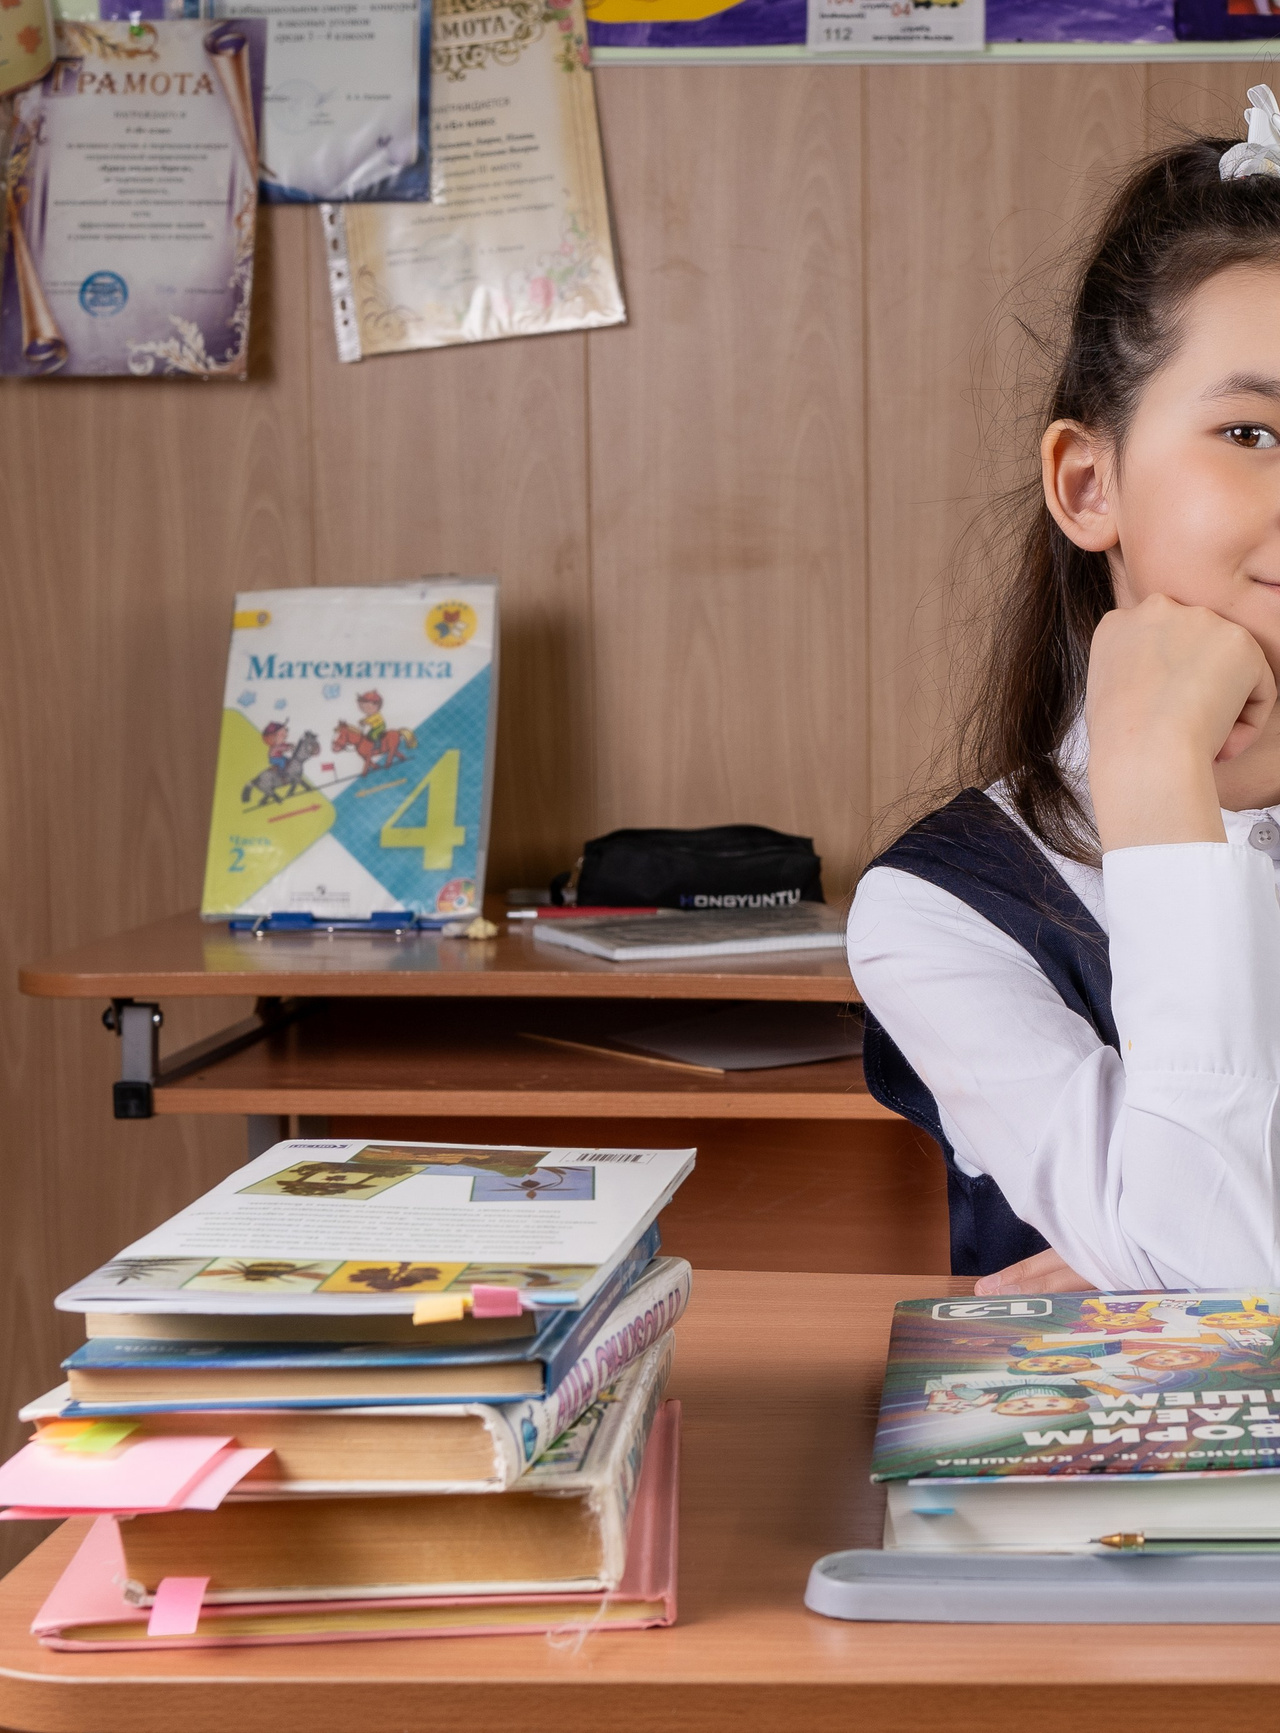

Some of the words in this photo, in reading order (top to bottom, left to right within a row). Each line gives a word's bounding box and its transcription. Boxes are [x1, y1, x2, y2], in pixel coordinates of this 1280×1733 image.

[824, 28, 852, 41] 112
[52, 57, 216, 95] ГРАМОТА
[246, 653, 454, 681] Математика
[380, 748, 466, 871] 4
[228, 847, 246, 872] 2
[949, 1301, 1036, 1318] 1-2
[935, 1454, 1073, 1466] КАРАШЕВА
